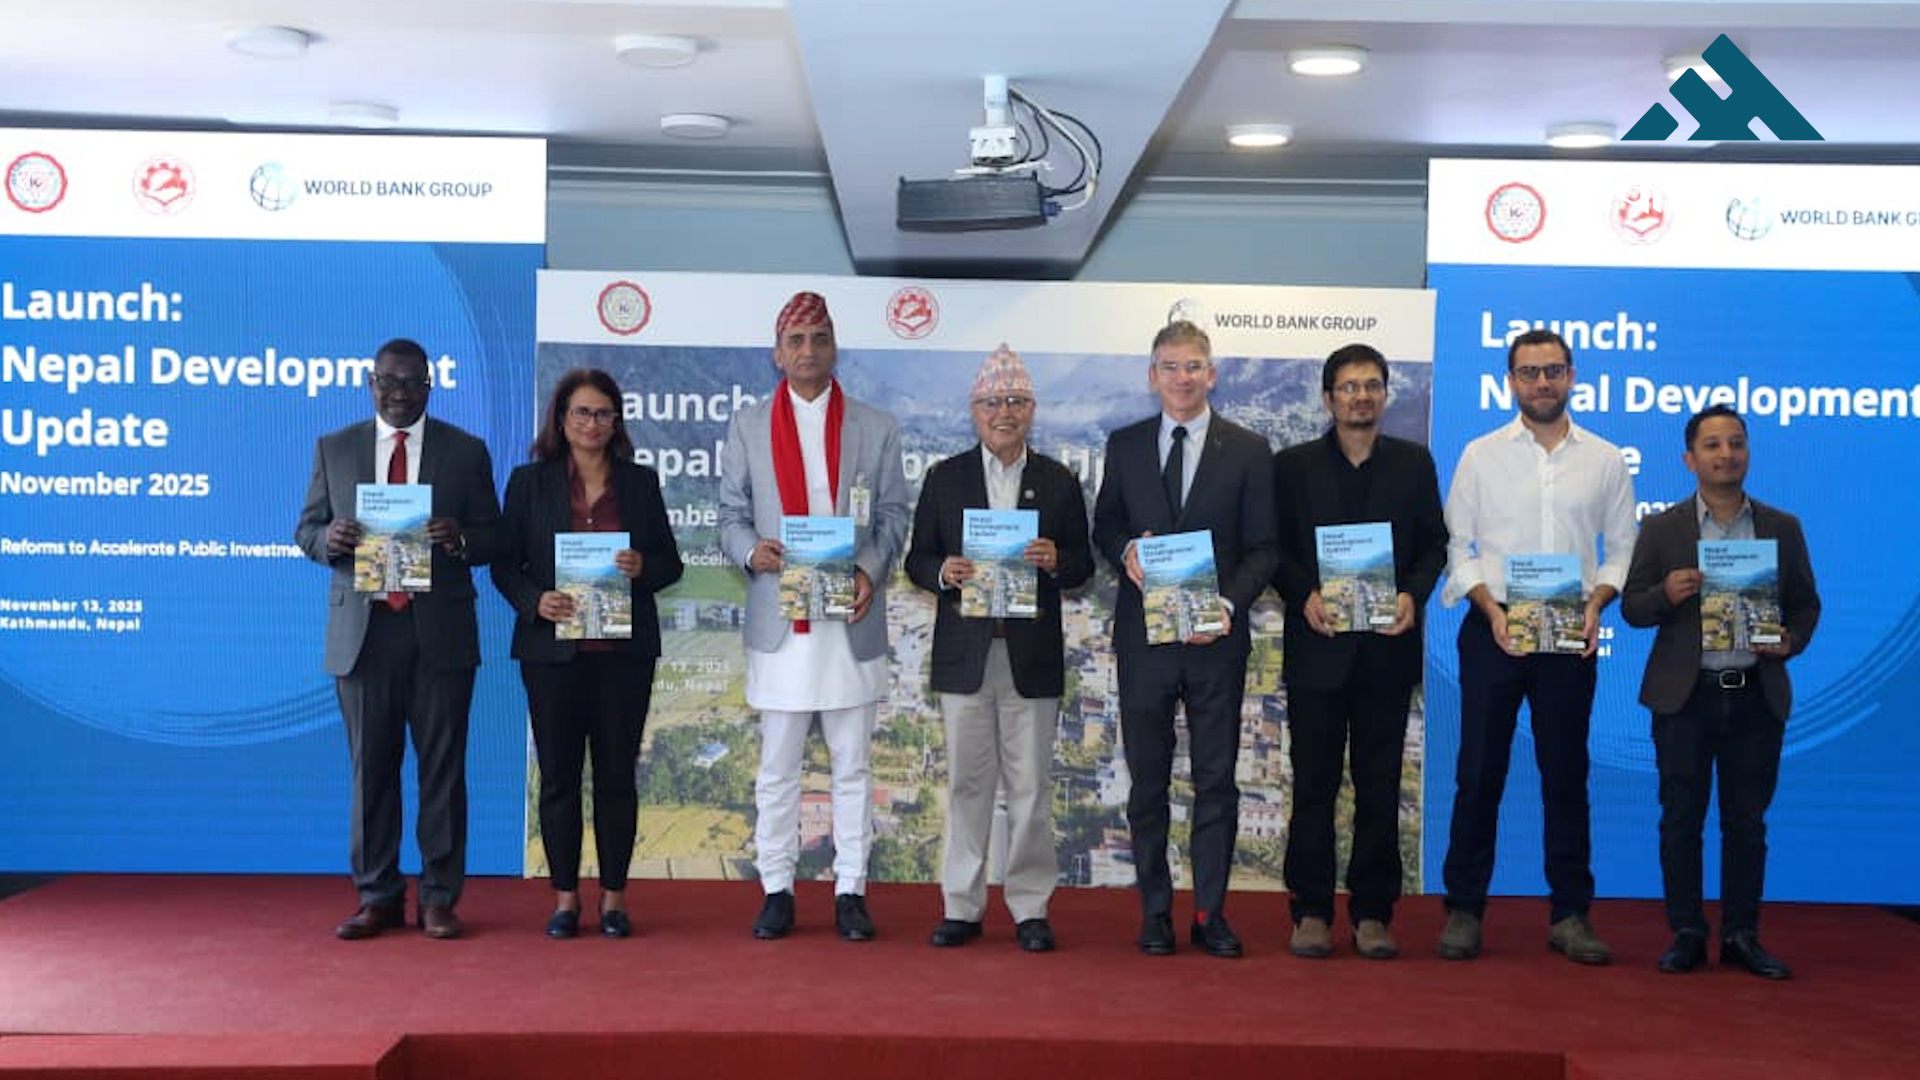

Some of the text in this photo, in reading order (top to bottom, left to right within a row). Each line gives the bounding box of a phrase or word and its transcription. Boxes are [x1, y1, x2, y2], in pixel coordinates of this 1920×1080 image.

[304, 179, 493, 198] WORLD BANK GROUP
[1780, 210, 1848, 225] WORLD
[1853, 210, 1902, 226] BANK
[3, 282, 183, 321] Launch:
[1215, 314, 1377, 331] WORLD BANK GROUP
[3, 344, 456, 398] Nepal Developmt
[1480, 373, 1610, 412] Nal
[3, 408, 169, 455] Update
[633, 439, 724, 487] epal
[1, 472, 210, 497] November 2025
[1, 538, 305, 558] Reforms to Accelerate Public Investme
[0, 599, 77, 613] November
[0, 616, 141, 633] Kathmandu, Nepal
